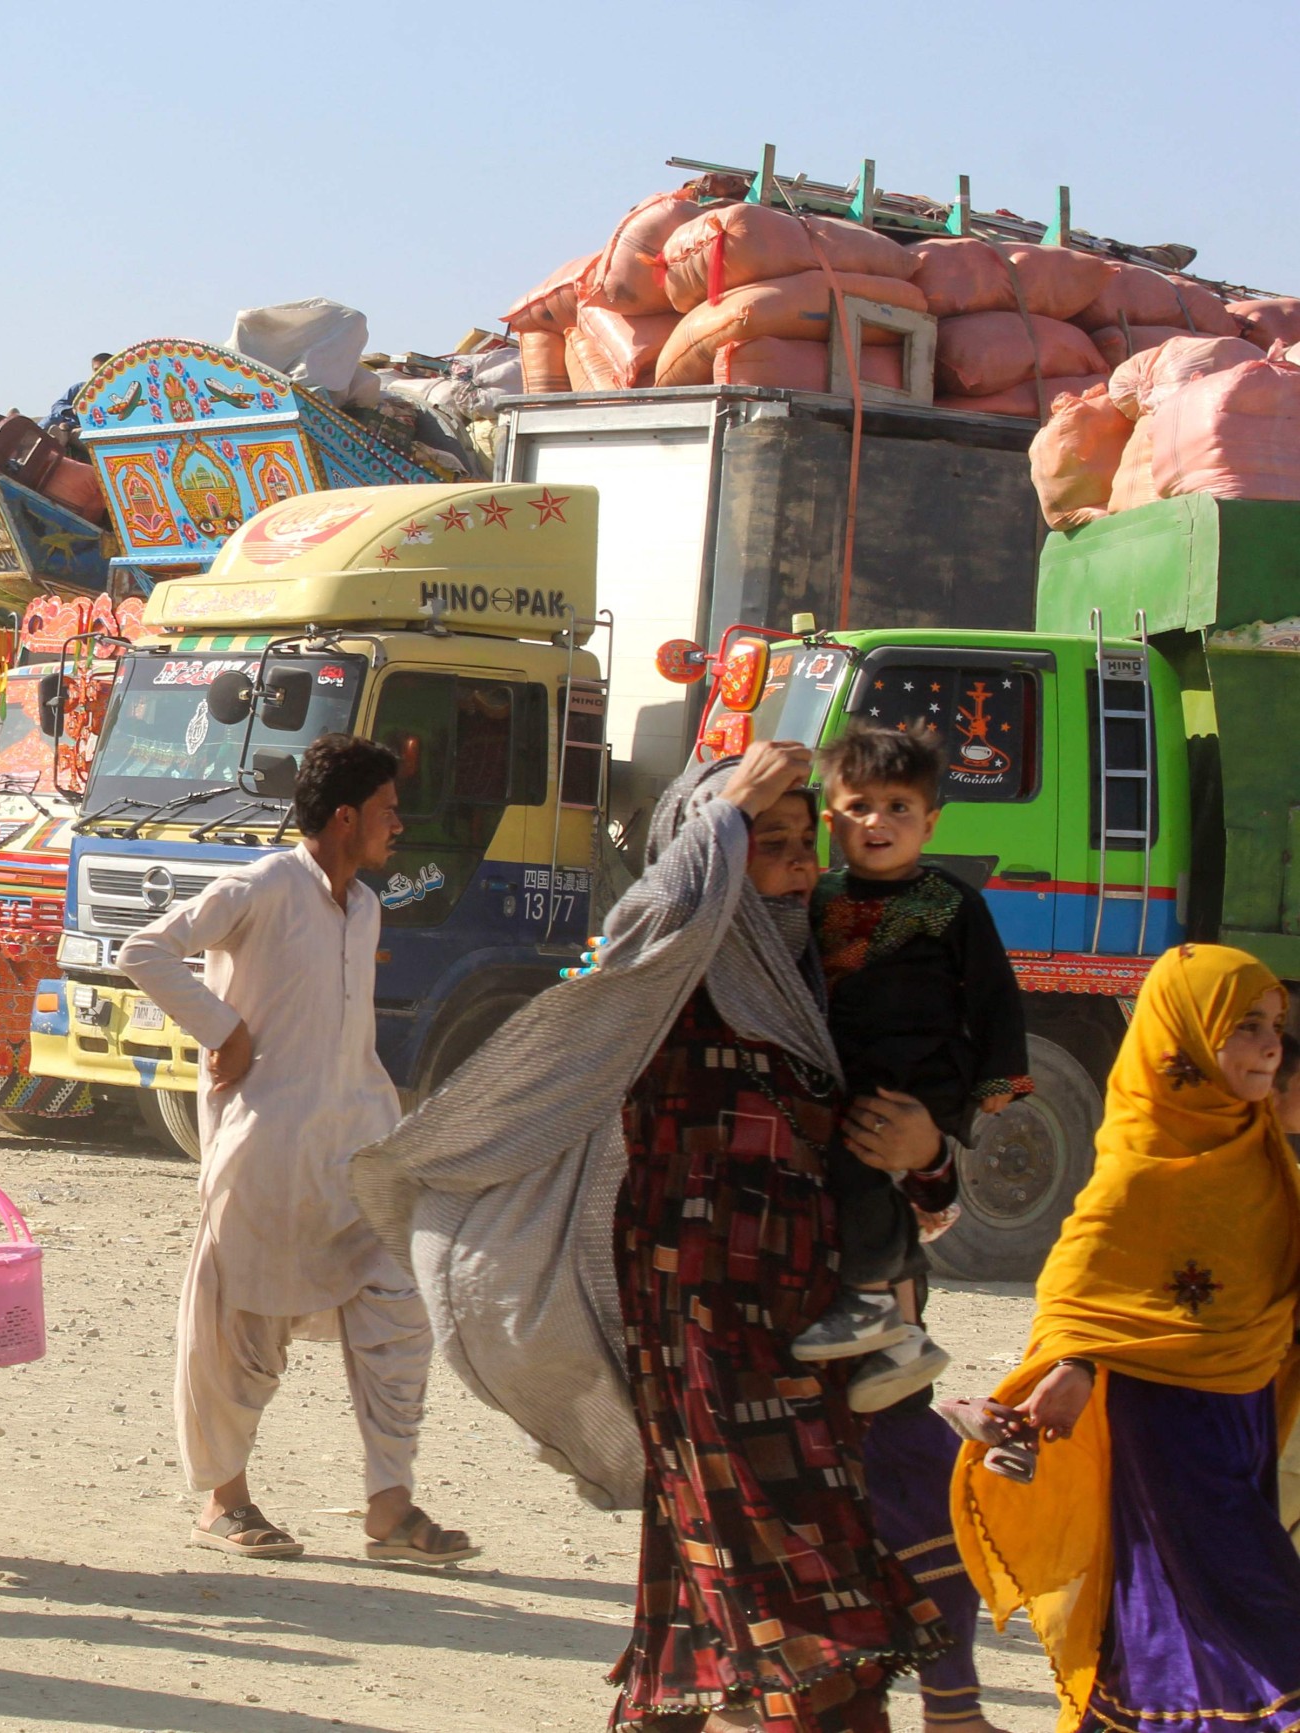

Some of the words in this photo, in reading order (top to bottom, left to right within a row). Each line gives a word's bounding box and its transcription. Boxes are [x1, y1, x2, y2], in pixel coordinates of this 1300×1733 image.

[420, 580, 489, 613] HINO
[514, 588, 566, 618] PAK
[1107, 661, 1142, 671] HINO
[571, 695, 604, 707] HINO
[948, 771, 1004, 785] Hookah
[523, 892, 576, 922] 1377
